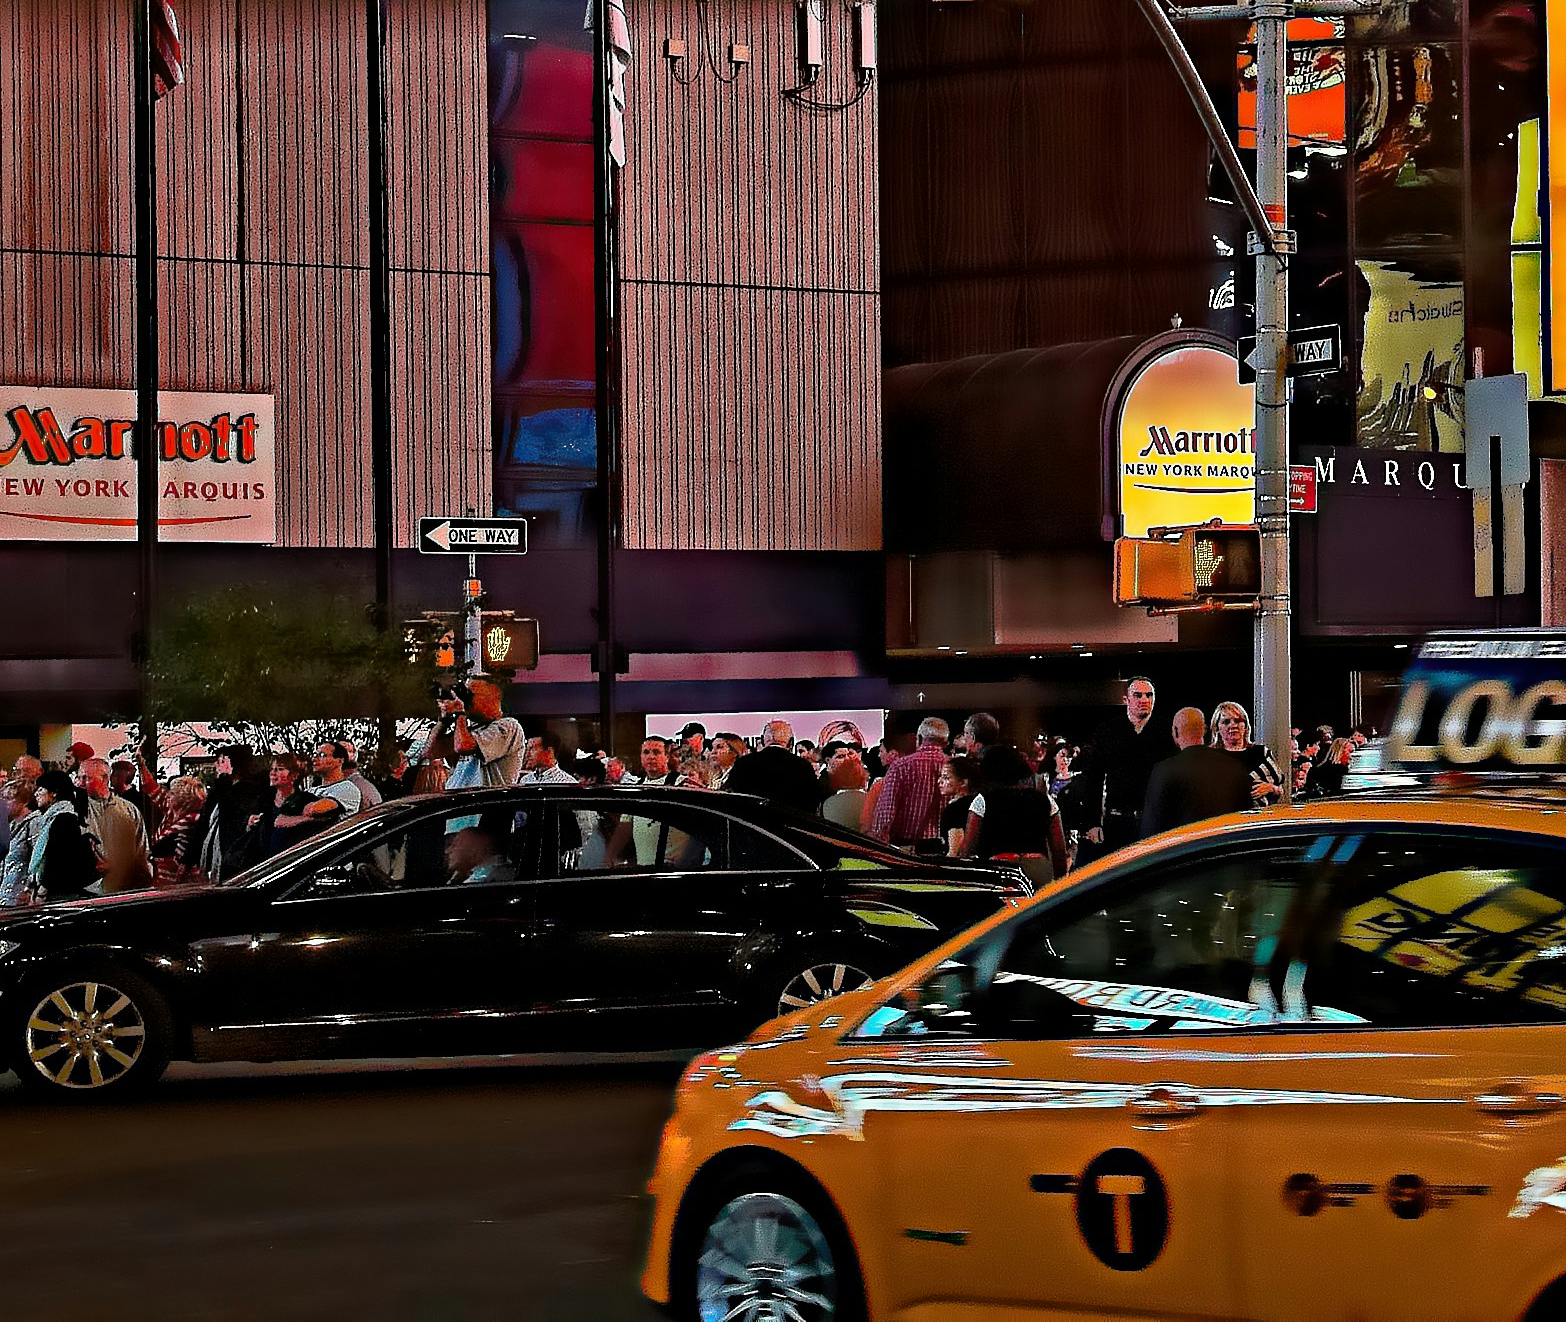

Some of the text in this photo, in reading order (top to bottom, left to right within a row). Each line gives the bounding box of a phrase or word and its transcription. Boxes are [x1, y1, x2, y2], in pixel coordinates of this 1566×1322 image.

[1293, 341, 1326, 363] WAY
[0, 405, 260, 466] Mariott
[1124, 462, 1158, 476] NEW
[1162, 463, 1203, 478] YORK
[55, 479, 130, 498] YORK
[163, 481, 265, 502] ARQUIS
[447, 528, 517, 544] ONE WAY
[1094, 1174, 1147, 1254] T
